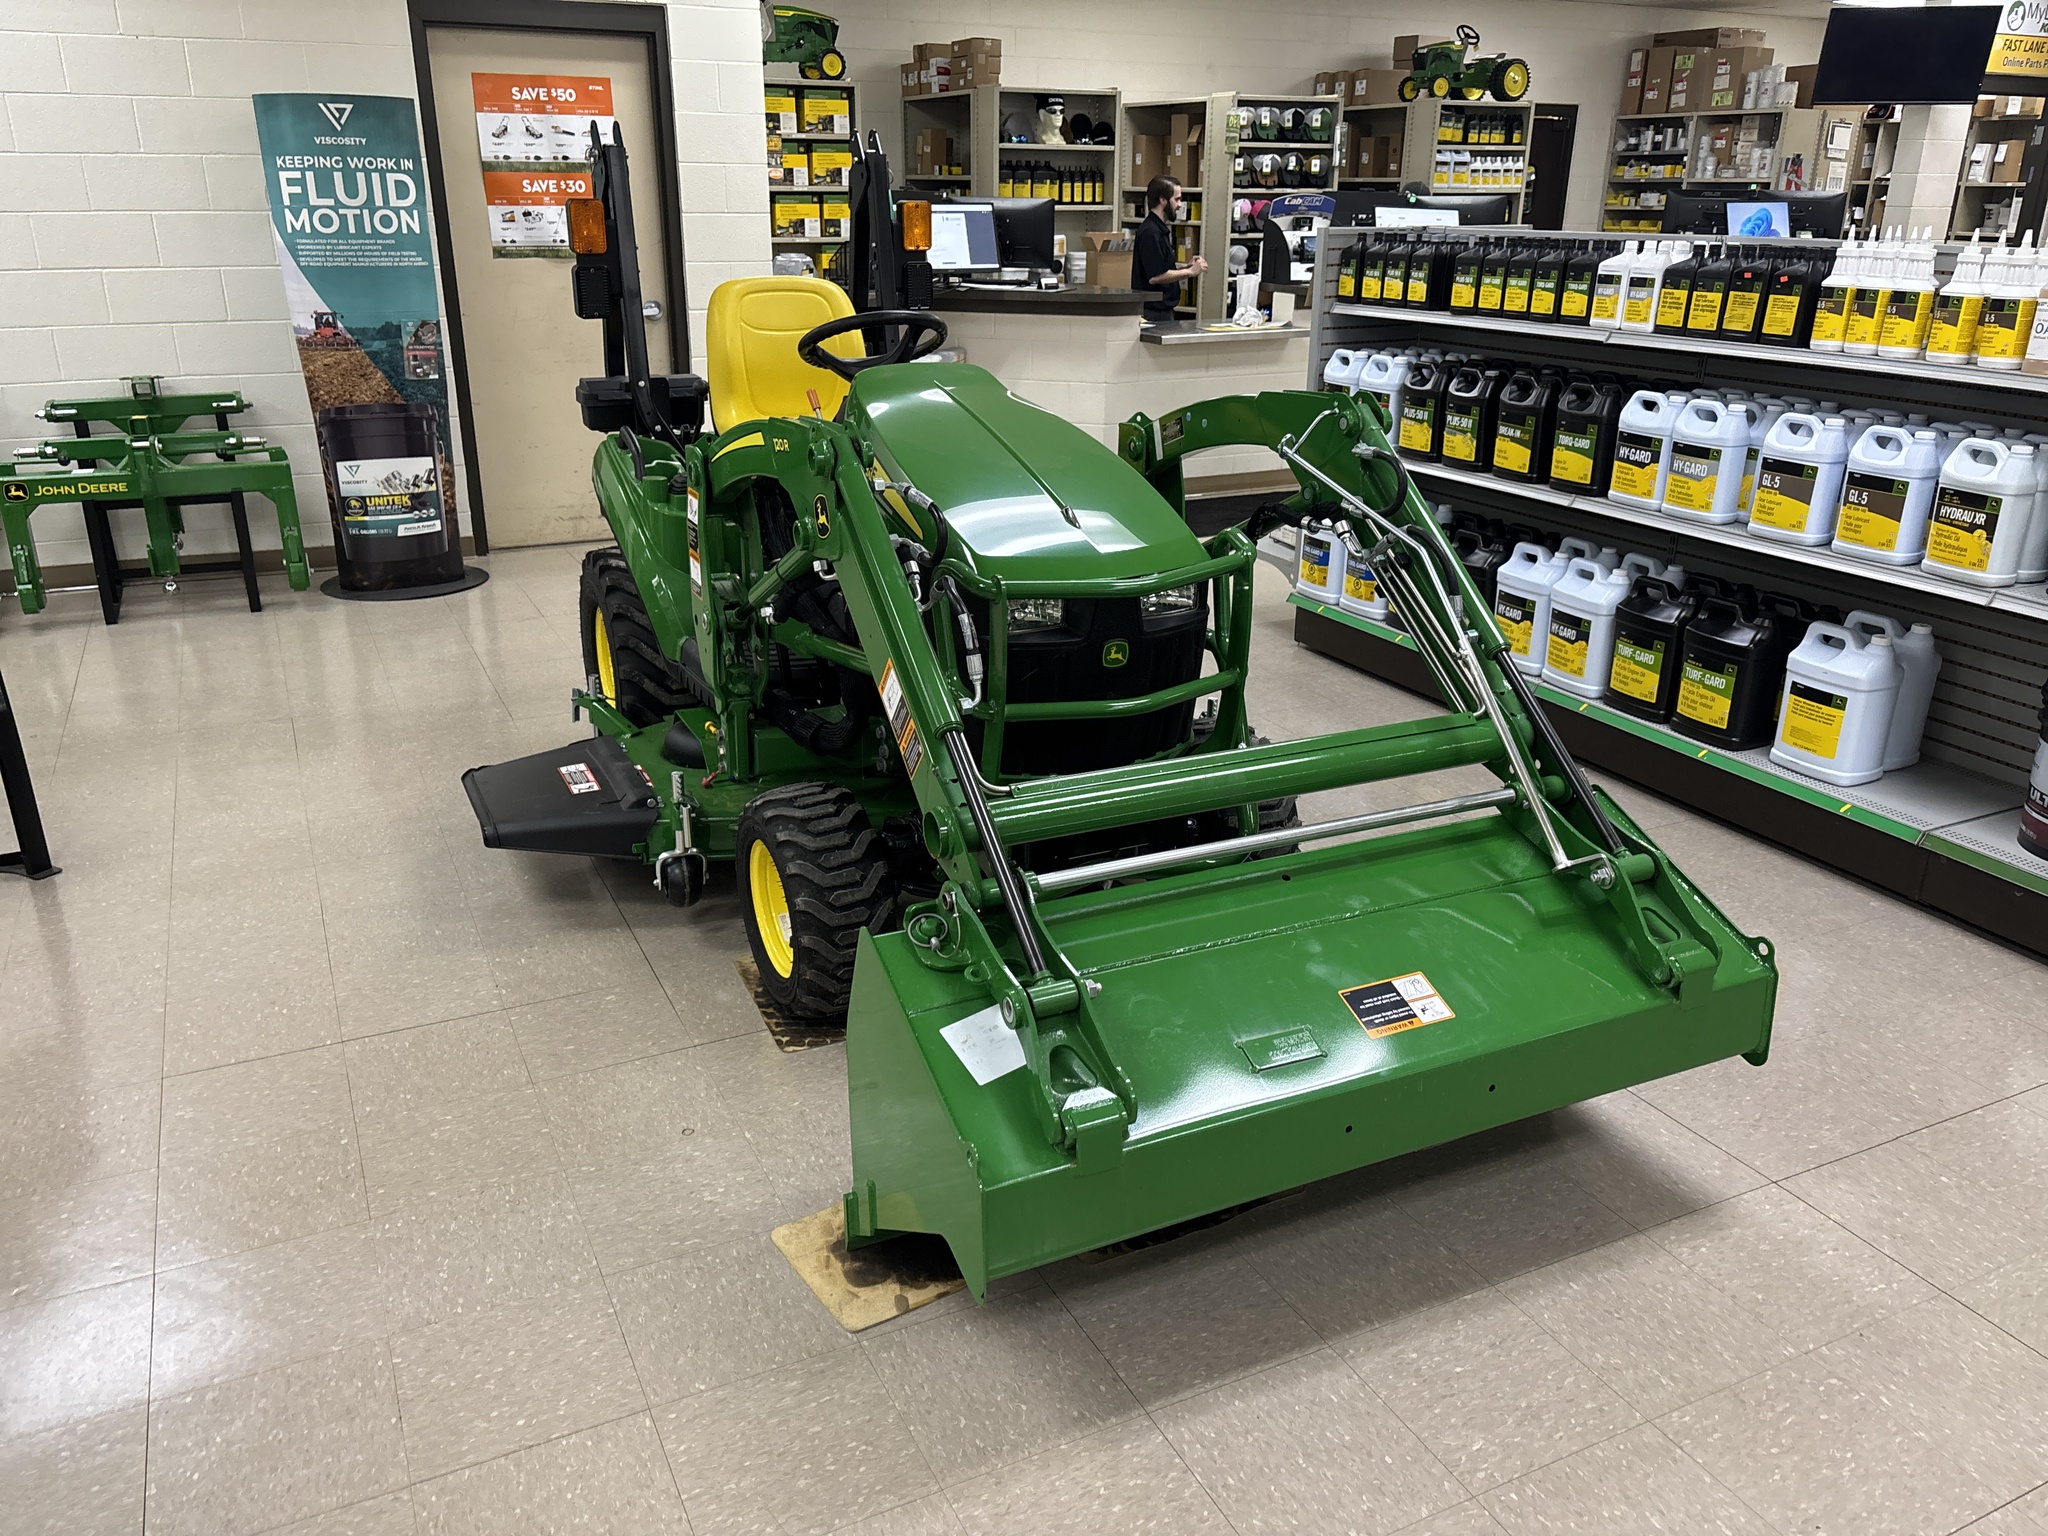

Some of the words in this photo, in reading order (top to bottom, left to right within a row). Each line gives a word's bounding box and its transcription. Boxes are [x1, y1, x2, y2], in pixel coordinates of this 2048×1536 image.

[2002, 39, 2024, 51] FAST
[2023, 40, 2047, 53] LANE
[2003, 56, 2024, 67] Online
[2025, 58, 2042, 68] Parts
[512, 87, 548, 100] SAVE
[551, 88, 576, 102] $50
[314, 136, 367, 145] VISCOSITY
[276, 156, 343, 168] KEEPING
[347, 157, 397, 170] WORK
[400, 158, 414, 171] IN
[278, 171, 416, 207] FLUID
[522, 179, 558, 192] SAVE
[560, 180, 586, 193] $30
[284, 208, 420, 234] MOTION
[1404, 407, 1423, 420] PLUS-50
[1424, 411, 1428, 420] II
[1446, 415, 1468, 428] PLUS-50
[1468, 419, 1473, 428] II
[1499, 425, 1521, 438] BREAK-IN
[1558, 434, 1590, 449] TORQ-GARD
[1619, 445, 1651, 463] HY-GARD
[1673, 459, 1708, 477] HY-GARD
[1762, 474, 1780, 488] GL-5
[34, 484, 75, 497] JOHN
[78, 482, 128, 494] DEERE
[1849, 489, 1868, 505] GL-5
[366, 495, 412, 507] UNITEK
[1940, 505, 1974, 523] HYDRAU
[1973, 513, 1986, 525] XR
[1497, 604, 1522, 620] HY-GARD
[1551, 623, 1576, 640] HY-GARD
[1617, 644, 1655, 664] TURF-GARD
[1686, 667, 1725, 689] TURF-GARD
[1376, 1022, 1409, 1034] WARNING
